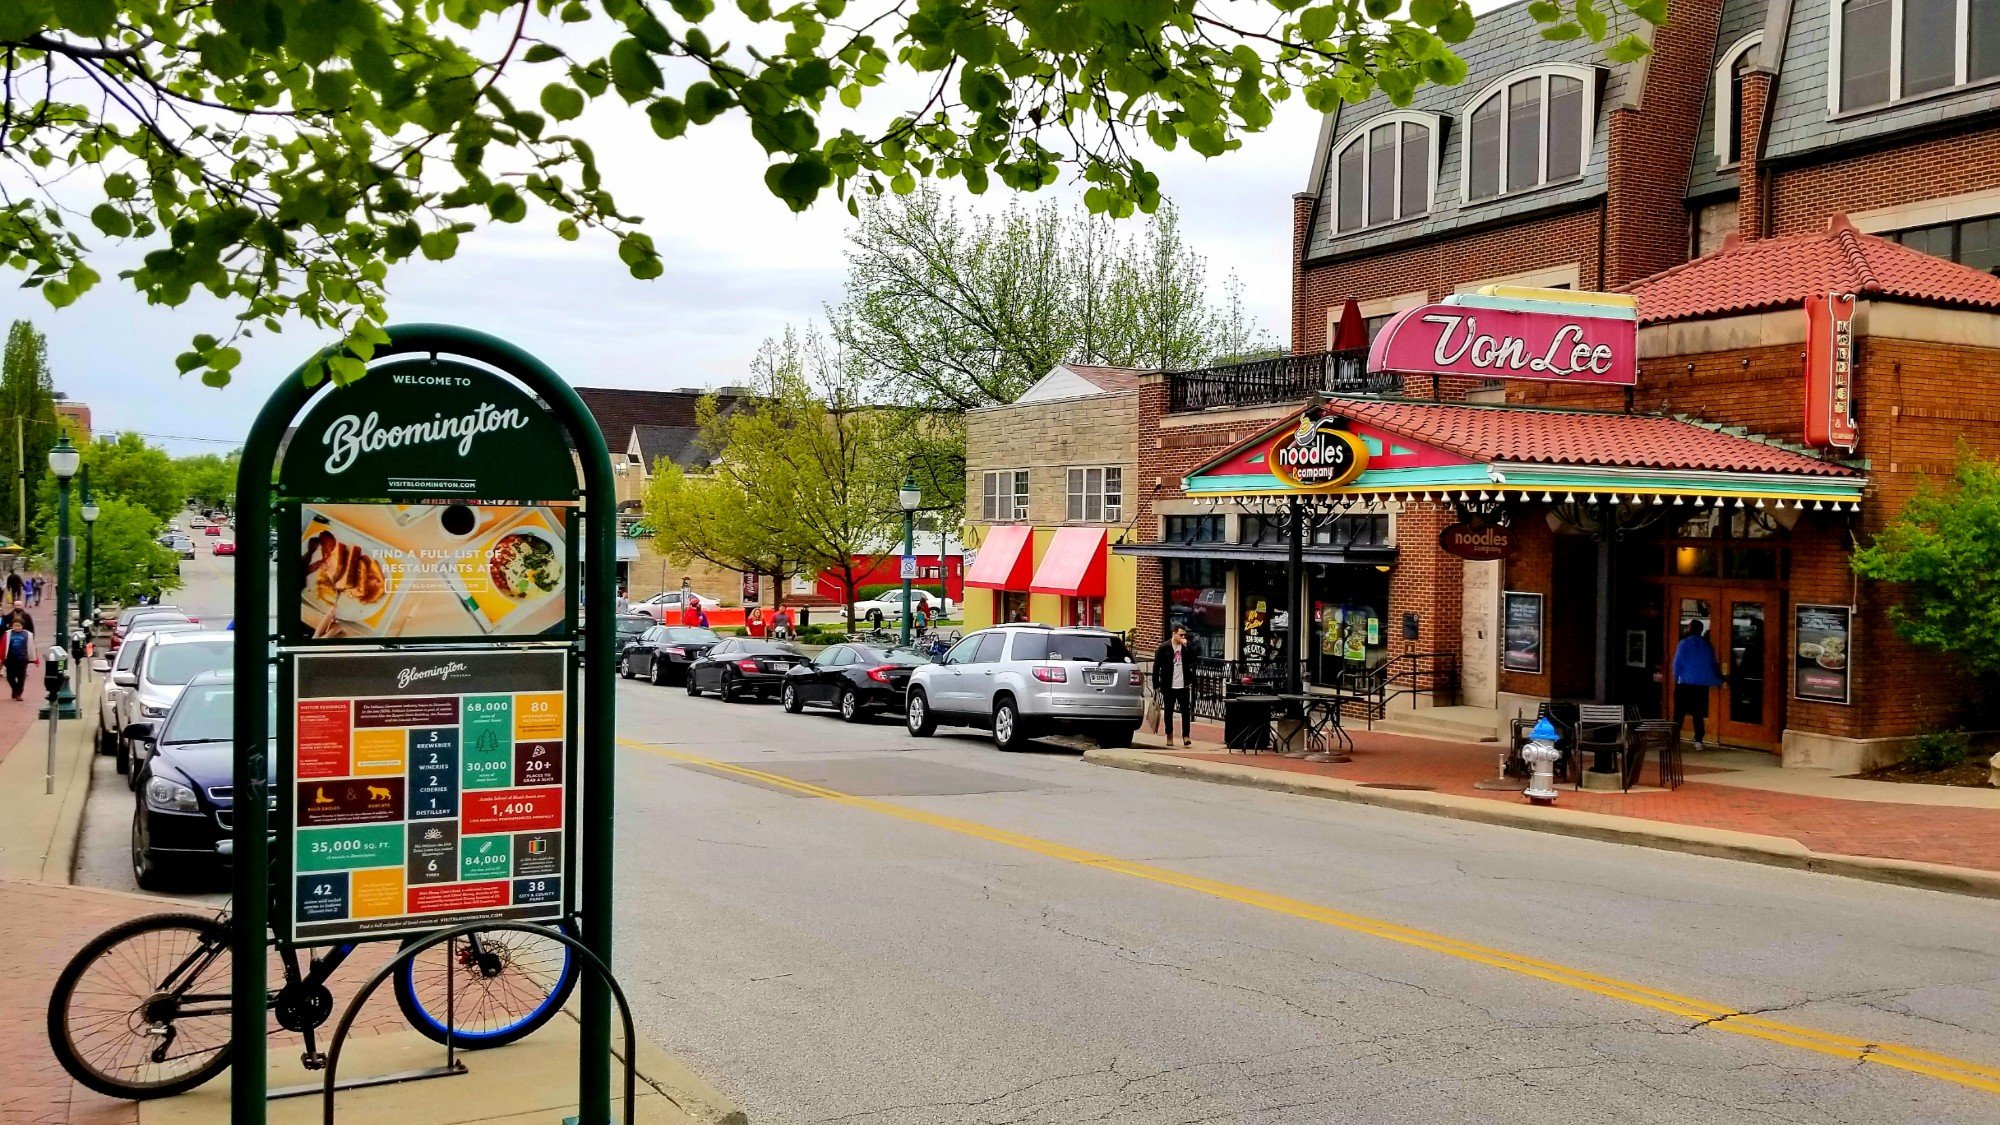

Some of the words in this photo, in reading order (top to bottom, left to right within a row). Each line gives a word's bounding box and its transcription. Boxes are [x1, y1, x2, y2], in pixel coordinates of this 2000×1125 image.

[1422, 313, 1531, 370] Von
[1530, 324, 1613, 376] Lee
[393, 375, 451, 386] WELCOME
[456, 377, 471, 386] TO
[321, 402, 529, 474] Bloomington
[1279, 434, 1343, 466] noodles
[388, 480, 476, 489] VISITBLOOMINGTON.COM
[1455, 528, 1508, 546] noodles
[372, 549, 404, 559] FIND
[407, 550, 416, 559] A
[420, 550, 449, 559] FULL
[454, 550, 482, 559] LIST
[486, 549, 502, 559] OF
[382, 564, 473, 573] RESTAURANTS
[477, 563, 494, 572] AT
[396, 662, 466, 688] Bloomington
[467, 702, 508, 712] 68,000
[530, 702, 548, 712] 80
[430, 731, 438, 742] 5
[430, 753, 438, 764] 2
[467, 761, 507, 772] 30,000
[525, 760, 552, 772] 20+
[430, 775, 438, 786] 2
[346, 788, 357, 800] &
[430, 798, 436, 809] 1
[491, 802, 534, 817] 1,400
[311, 840, 361, 853] 35,000
[428, 859, 438, 872] 6
[465, 854, 506, 866] 84,000
[313, 884, 332, 896] 42
[528, 881, 545, 892] 38
[440, 913, 503, 923] VISITBLOOMINGTON.COM
